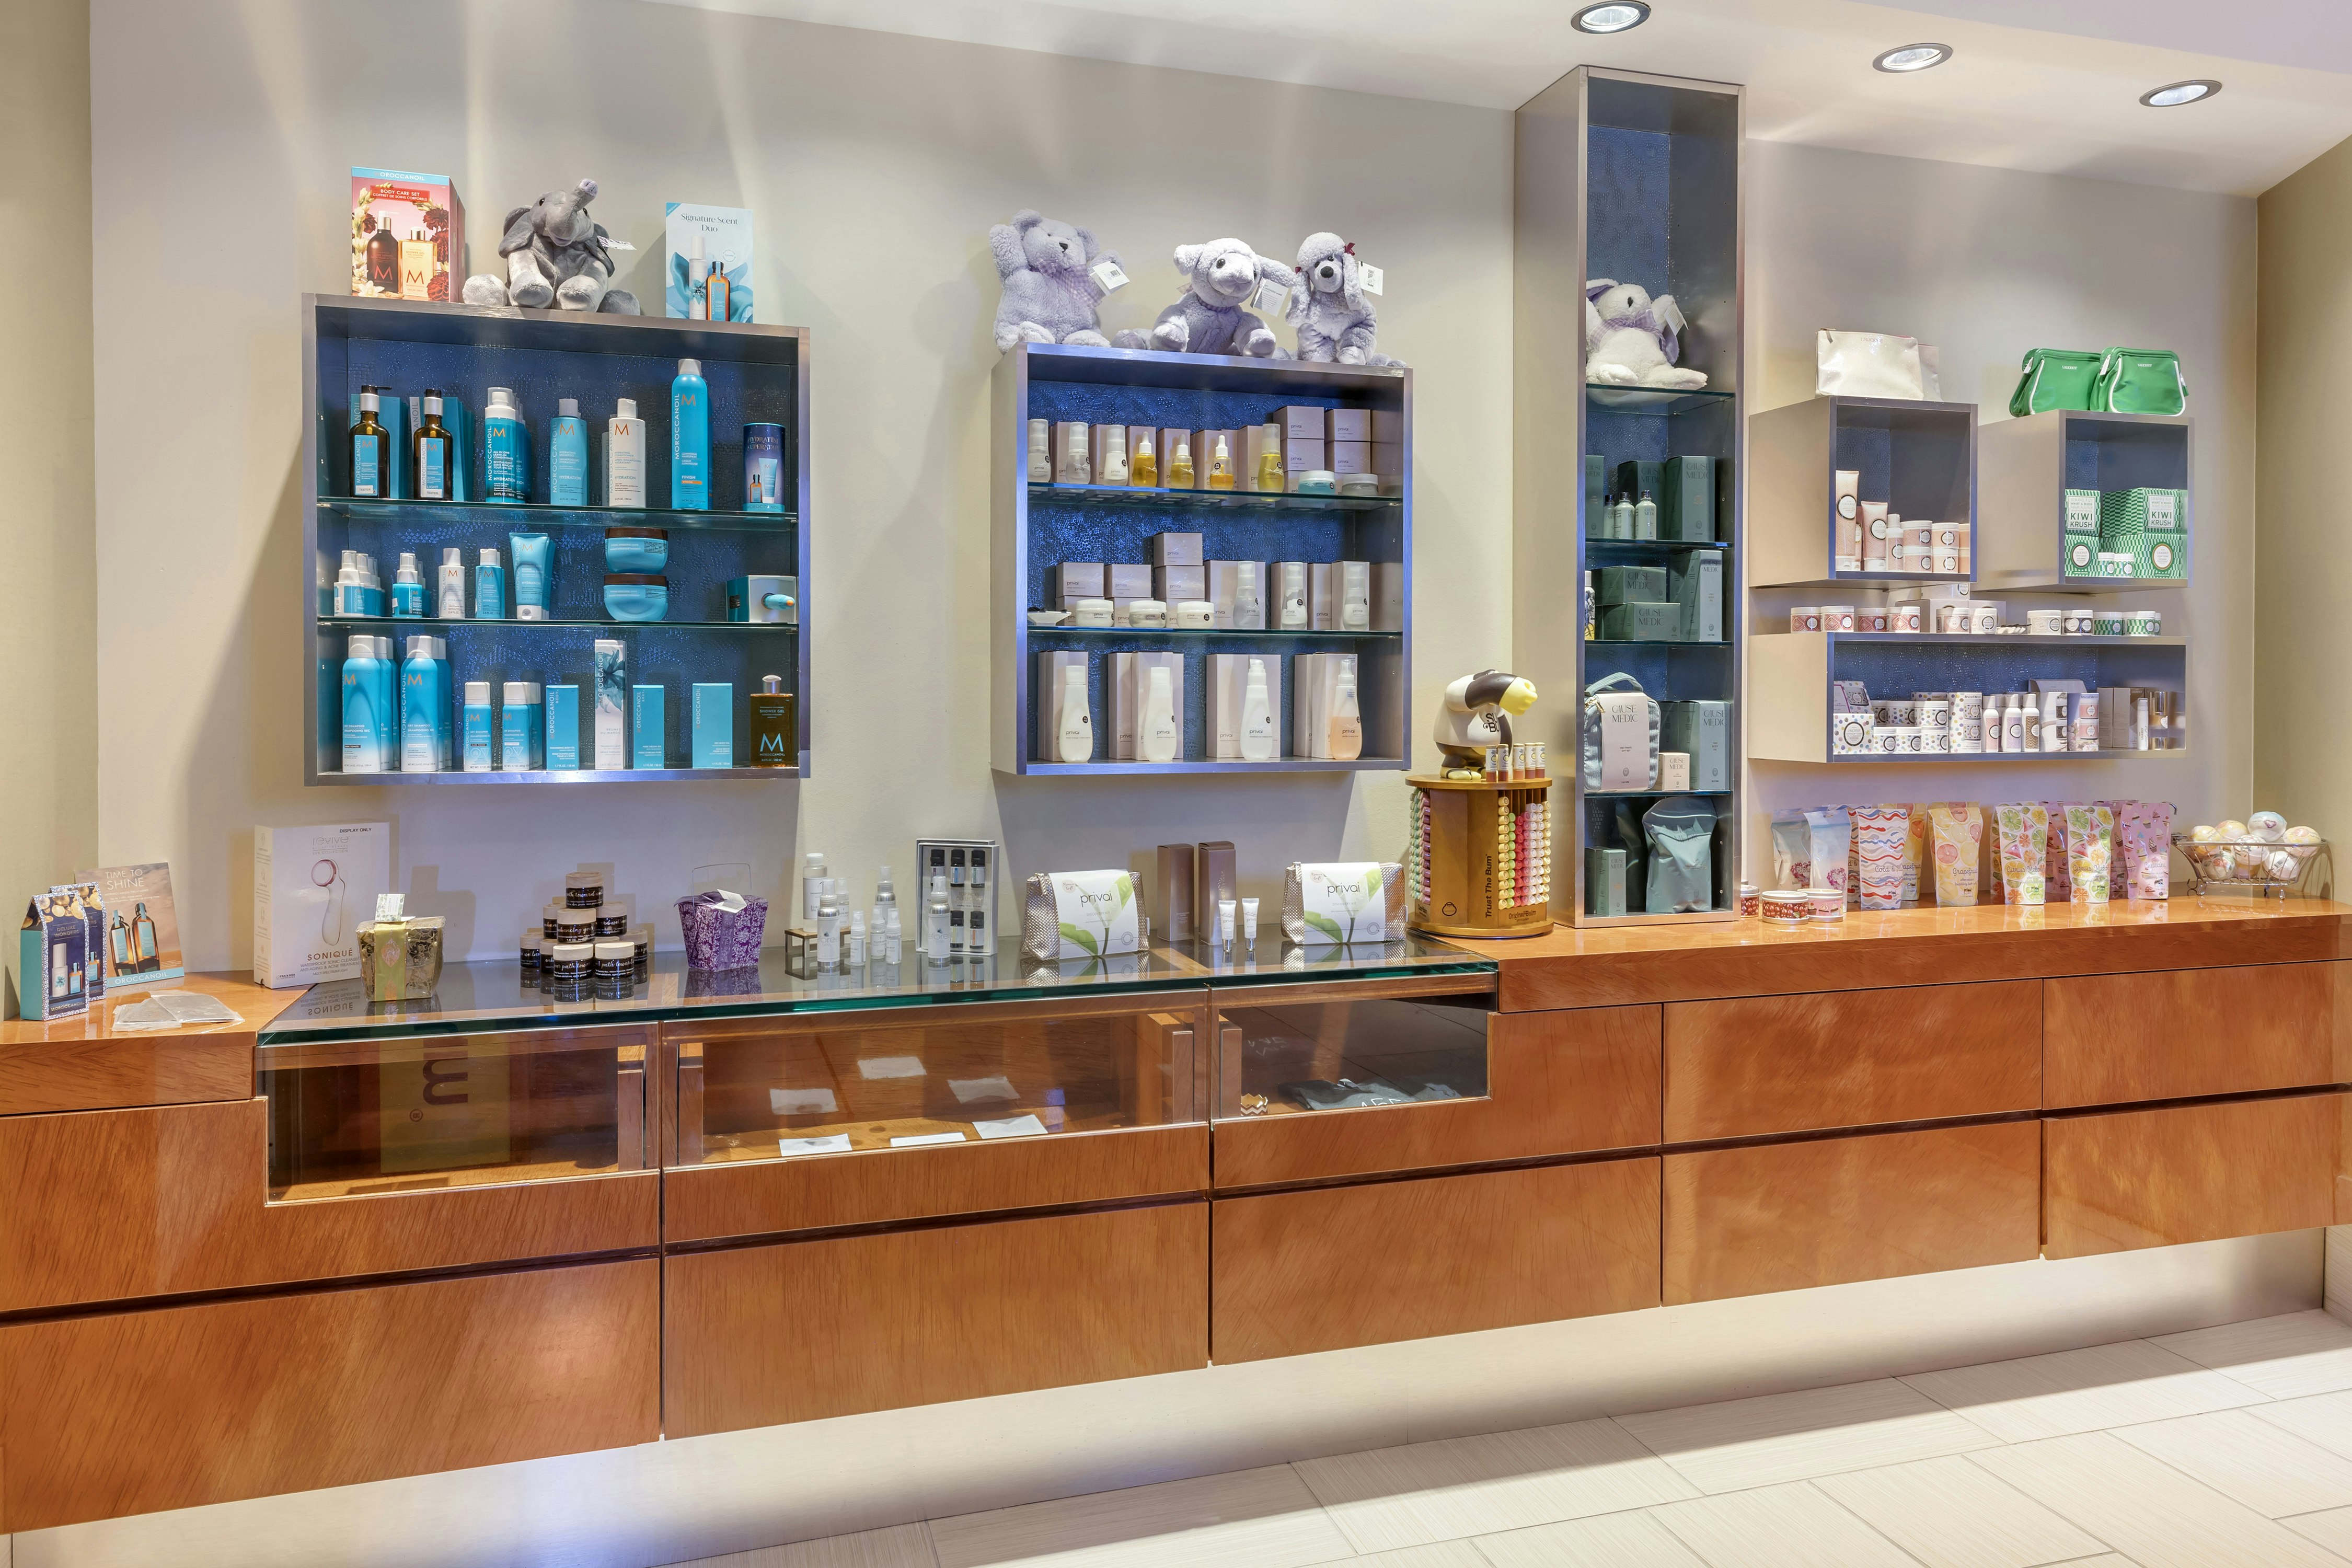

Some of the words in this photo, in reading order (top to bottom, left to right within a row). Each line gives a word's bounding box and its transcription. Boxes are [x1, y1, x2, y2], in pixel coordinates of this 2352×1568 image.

[681, 213, 716, 223] Signature
[717, 216, 738, 225] Scent
[374, 265, 393, 281] M
[407, 269, 424, 285] M
[682, 394, 696, 406] M
[493, 428, 505, 437] M
[560, 423, 574, 435] M
[615, 423, 629, 435] M
[1627, 581, 1652, 590] MEDIC
[1639, 618, 1665, 626] MEDIC
[344, 674, 356, 685] M
[408, 674, 422, 685] M
[1612, 714, 1638, 723] MEDIC
[760, 733, 783, 752] M
[313, 836, 349, 845] revive
[105, 870, 126, 879] TIME
[107, 878, 144, 890] SHINE
[1327, 882, 1360, 897] privai
[1080, 891, 1113, 907] privai
[307, 948, 353, 961] SONIQUÉ
[562, 962, 575, 971] path
[51, 1002, 84, 1011] MOROCCANOIL
